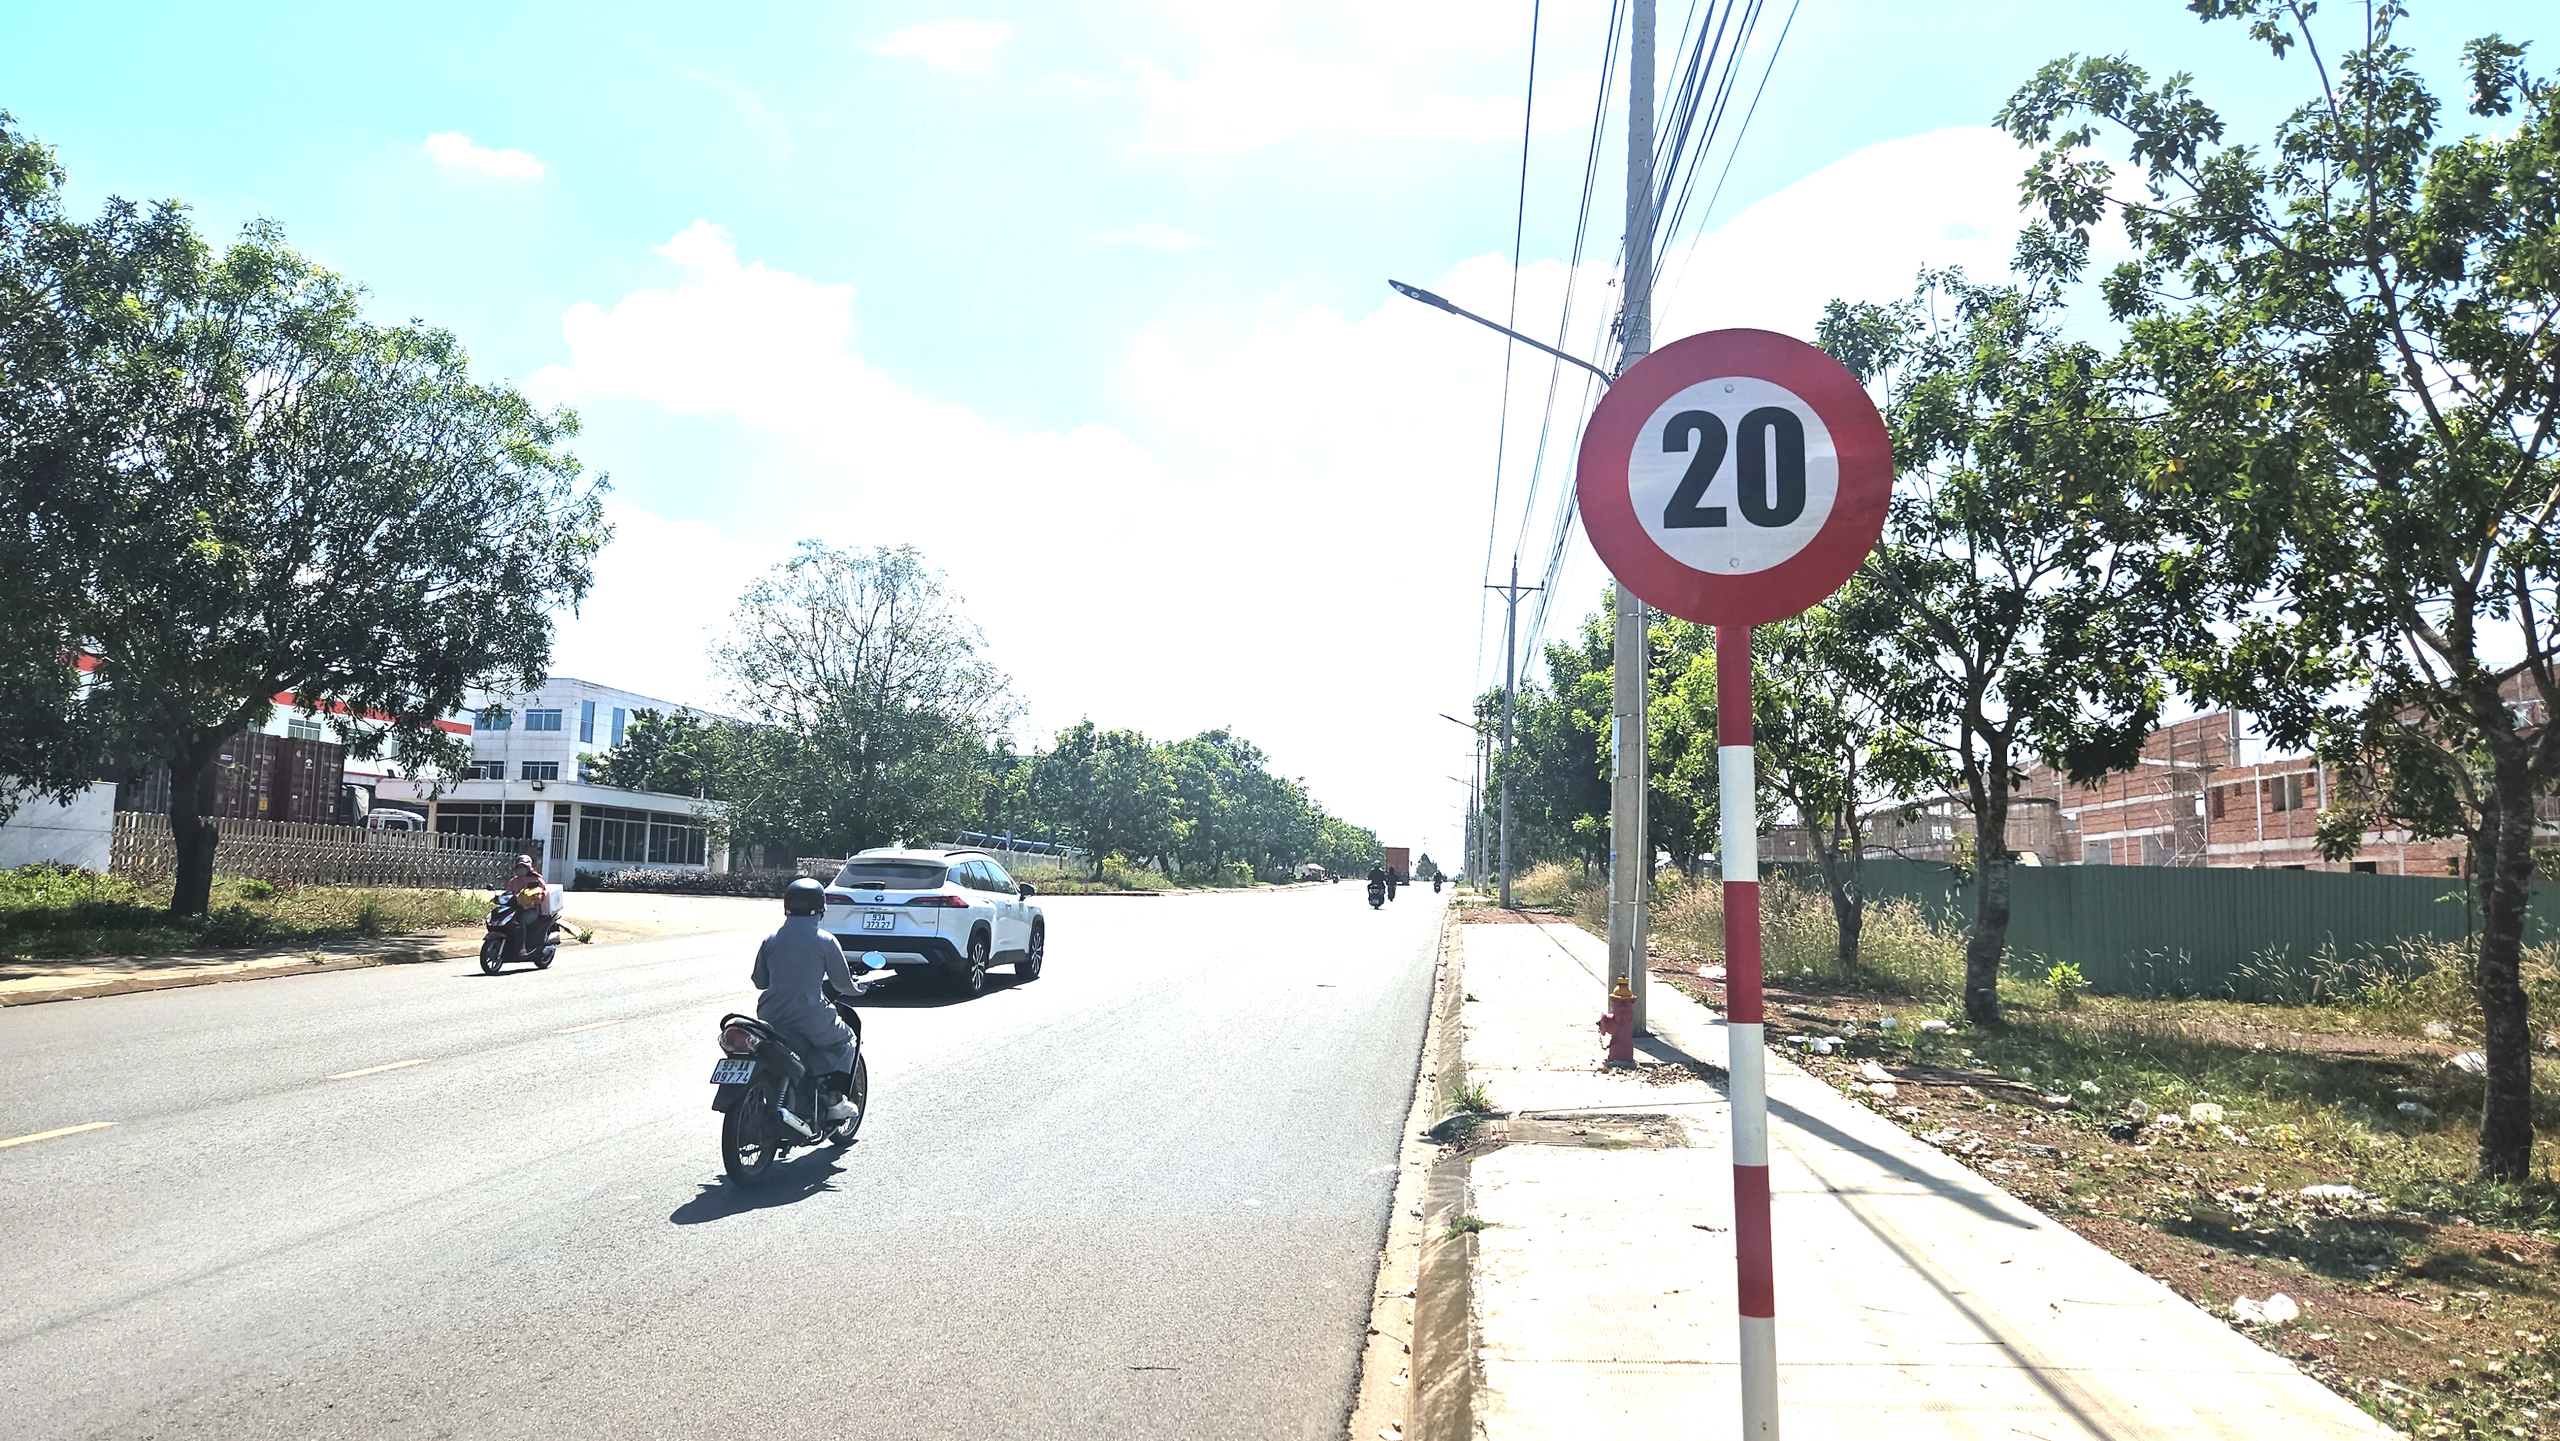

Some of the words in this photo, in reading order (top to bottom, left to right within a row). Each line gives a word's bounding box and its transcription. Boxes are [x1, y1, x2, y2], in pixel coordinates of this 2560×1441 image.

[1662, 406, 1806, 529] 20
[722, 1061, 749, 1071] 93-AA
[714, 1071, 749, 1082] 097.74
